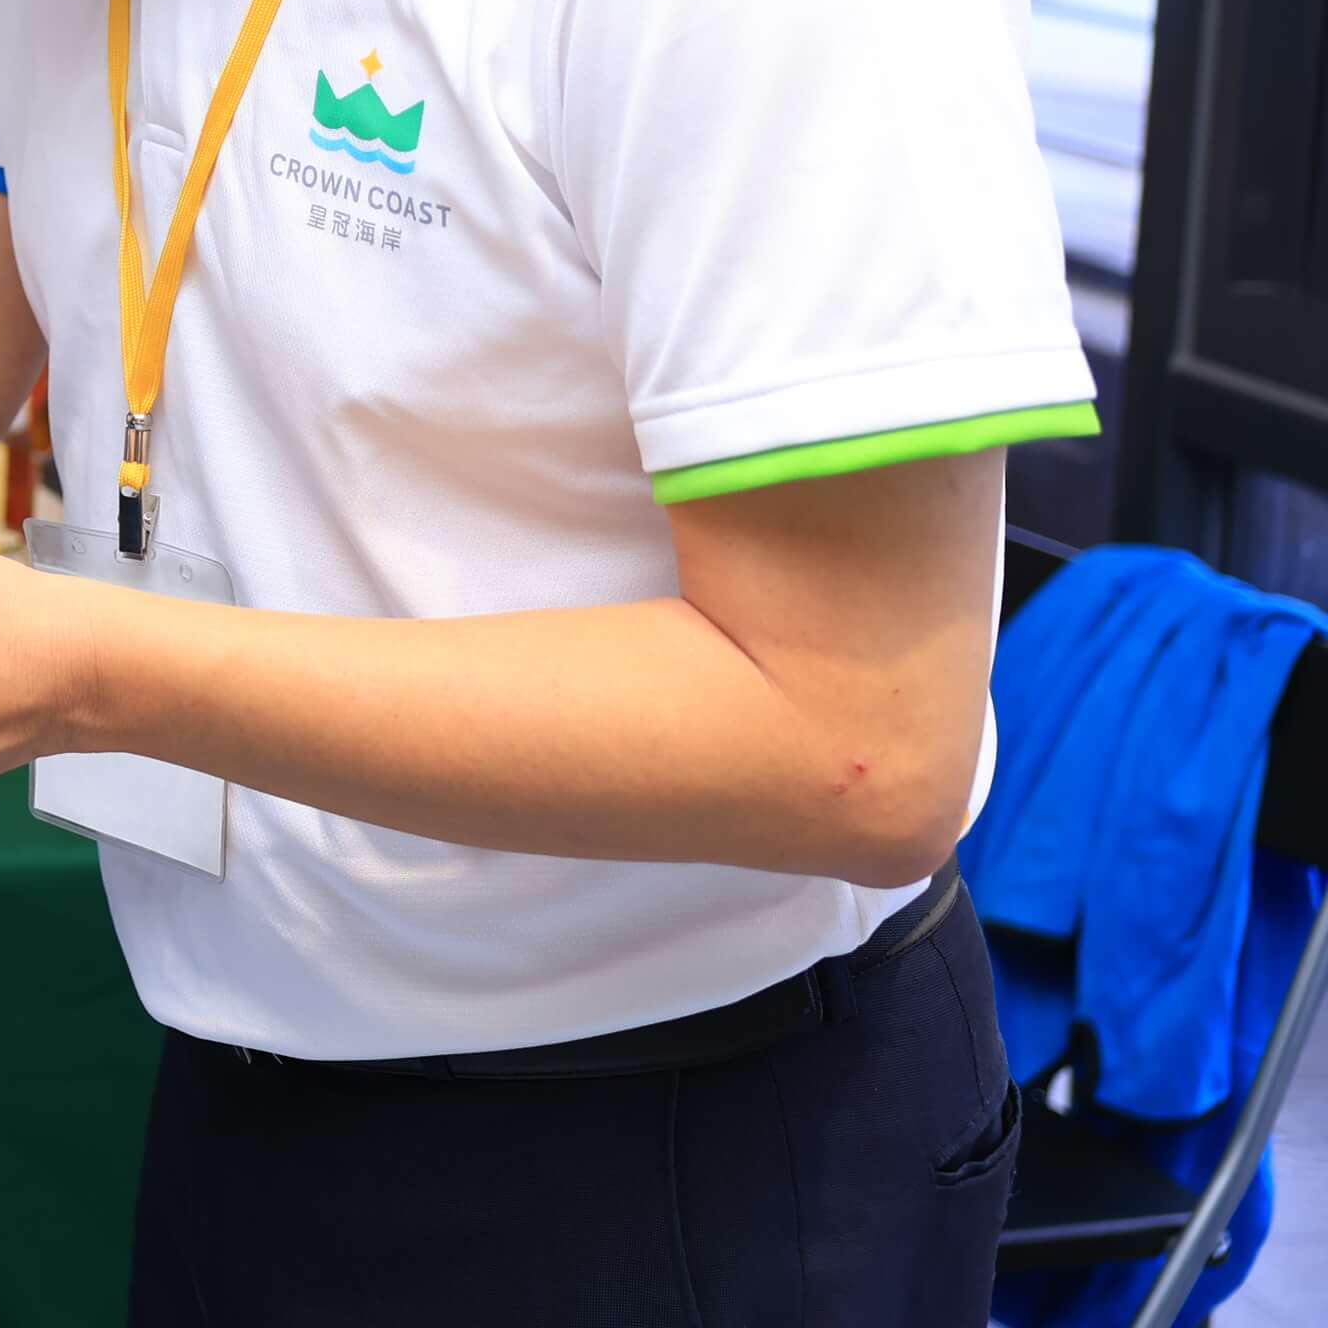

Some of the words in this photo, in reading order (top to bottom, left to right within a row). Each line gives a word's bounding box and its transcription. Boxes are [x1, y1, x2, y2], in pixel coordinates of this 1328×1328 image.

[269, 153, 362, 203] CROWN
[367, 186, 452, 228] COAST
[306, 204, 403, 252] 皇冠海岸
